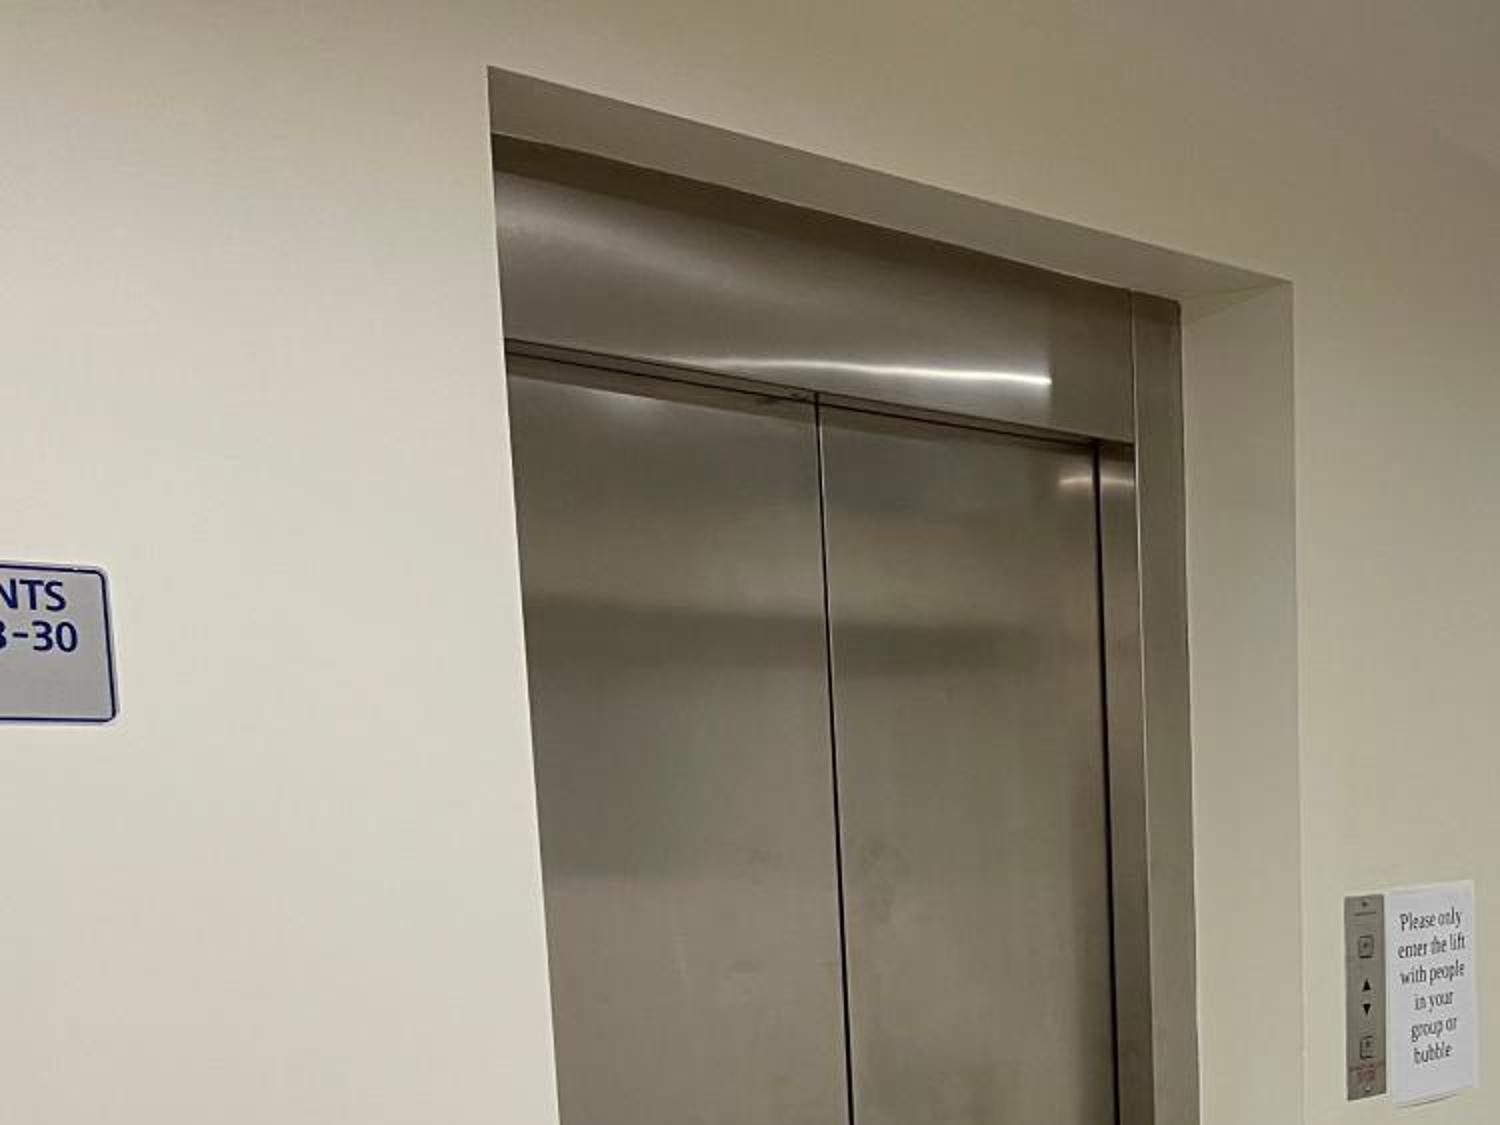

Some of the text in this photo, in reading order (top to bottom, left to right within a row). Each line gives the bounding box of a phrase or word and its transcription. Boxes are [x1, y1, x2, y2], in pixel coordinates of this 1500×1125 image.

[1400, 906, 1463, 932] Please only
[1398, 932, 1465, 959] enter the lift
[1400, 960, 1465, 987] with people
[1414, 991, 1454, 1013] in your
[1411, 1016, 1457, 1042] group or
[1413, 1041, 1453, 1065] bubble
